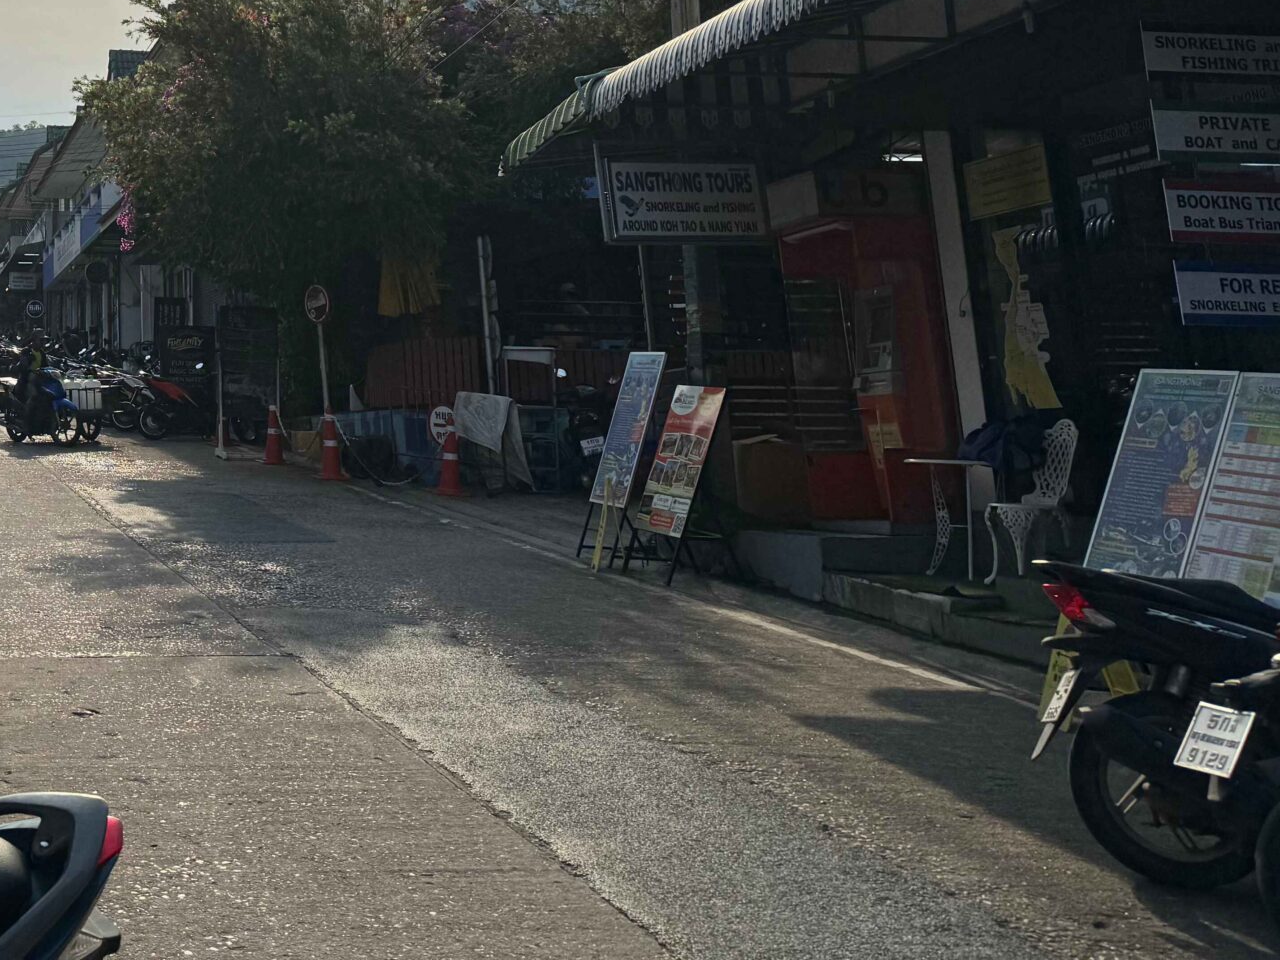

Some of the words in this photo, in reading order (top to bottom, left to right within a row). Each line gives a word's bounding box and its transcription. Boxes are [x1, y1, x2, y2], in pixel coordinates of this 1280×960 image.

[1155, 35, 1256, 52] SNORKELING
[1182, 56, 1248, 72] FISHING
[1198, 115, 1272, 132] PRIVATE
[1184, 136, 1223, 149] BOAT
[1232, 137, 1258, 150] and
[615, 171, 703, 193] SANGTHONG
[705, 172, 753, 193] TOURS
[645, 201, 701, 213] SNORKELING
[703, 202, 719, 213] and
[722, 202, 756, 213] FISHING
[1176, 194, 1252, 211] BOOKING
[622, 220, 658, 232] AROUND
[660, 221, 678, 232] KOH
[680, 221, 697, 232] TAO
[699, 221, 706, 232] &
[708, 221, 732, 233] NANG
[735, 221, 758, 233] YUAN
[1184, 216, 1215, 228] Boat
[1219, 217, 1244, 230] Bus
[1219, 278, 1255, 294] FOR
[1190, 299, 1266, 312] SNORKELING
[1186, 747, 1229, 770] 9129
